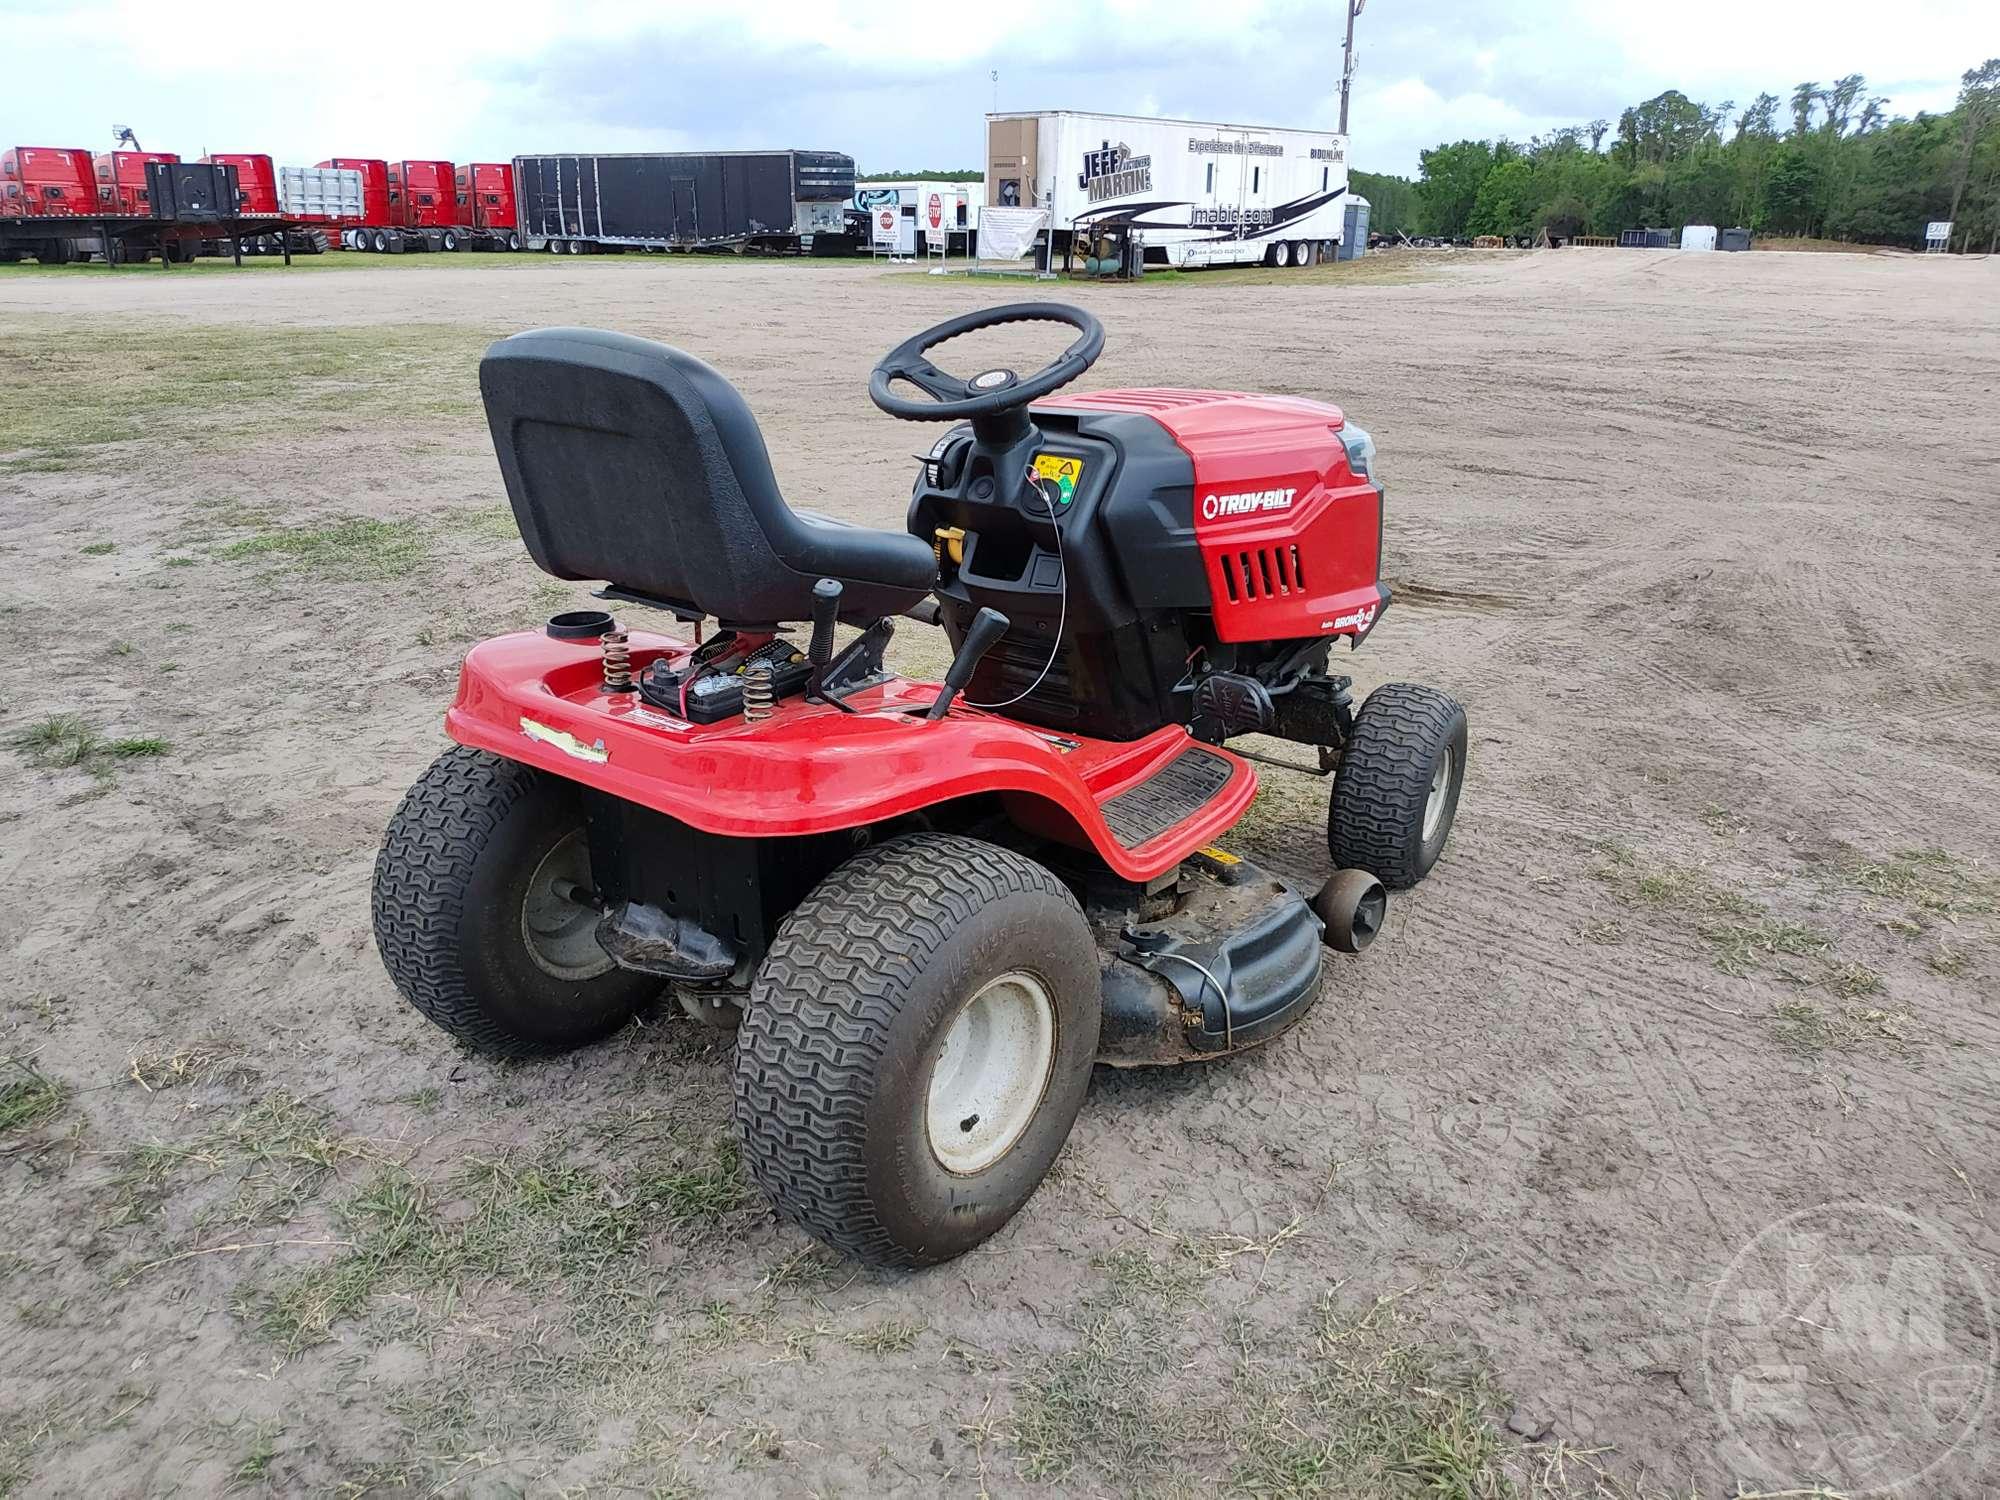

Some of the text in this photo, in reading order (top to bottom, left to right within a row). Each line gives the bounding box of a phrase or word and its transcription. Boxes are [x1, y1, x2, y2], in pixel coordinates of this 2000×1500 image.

[1189, 138, 1234, 155] Experience
[1079, 147, 1119, 189] JEFF
[1088, 168, 1145, 202] MARTIN
[880, 217, 893, 225] STOP
[929, 207, 942, 219] STOP
[1188, 203, 1274, 227] jmabid.com
[1218, 487, 1297, 516] TROY-BILT
